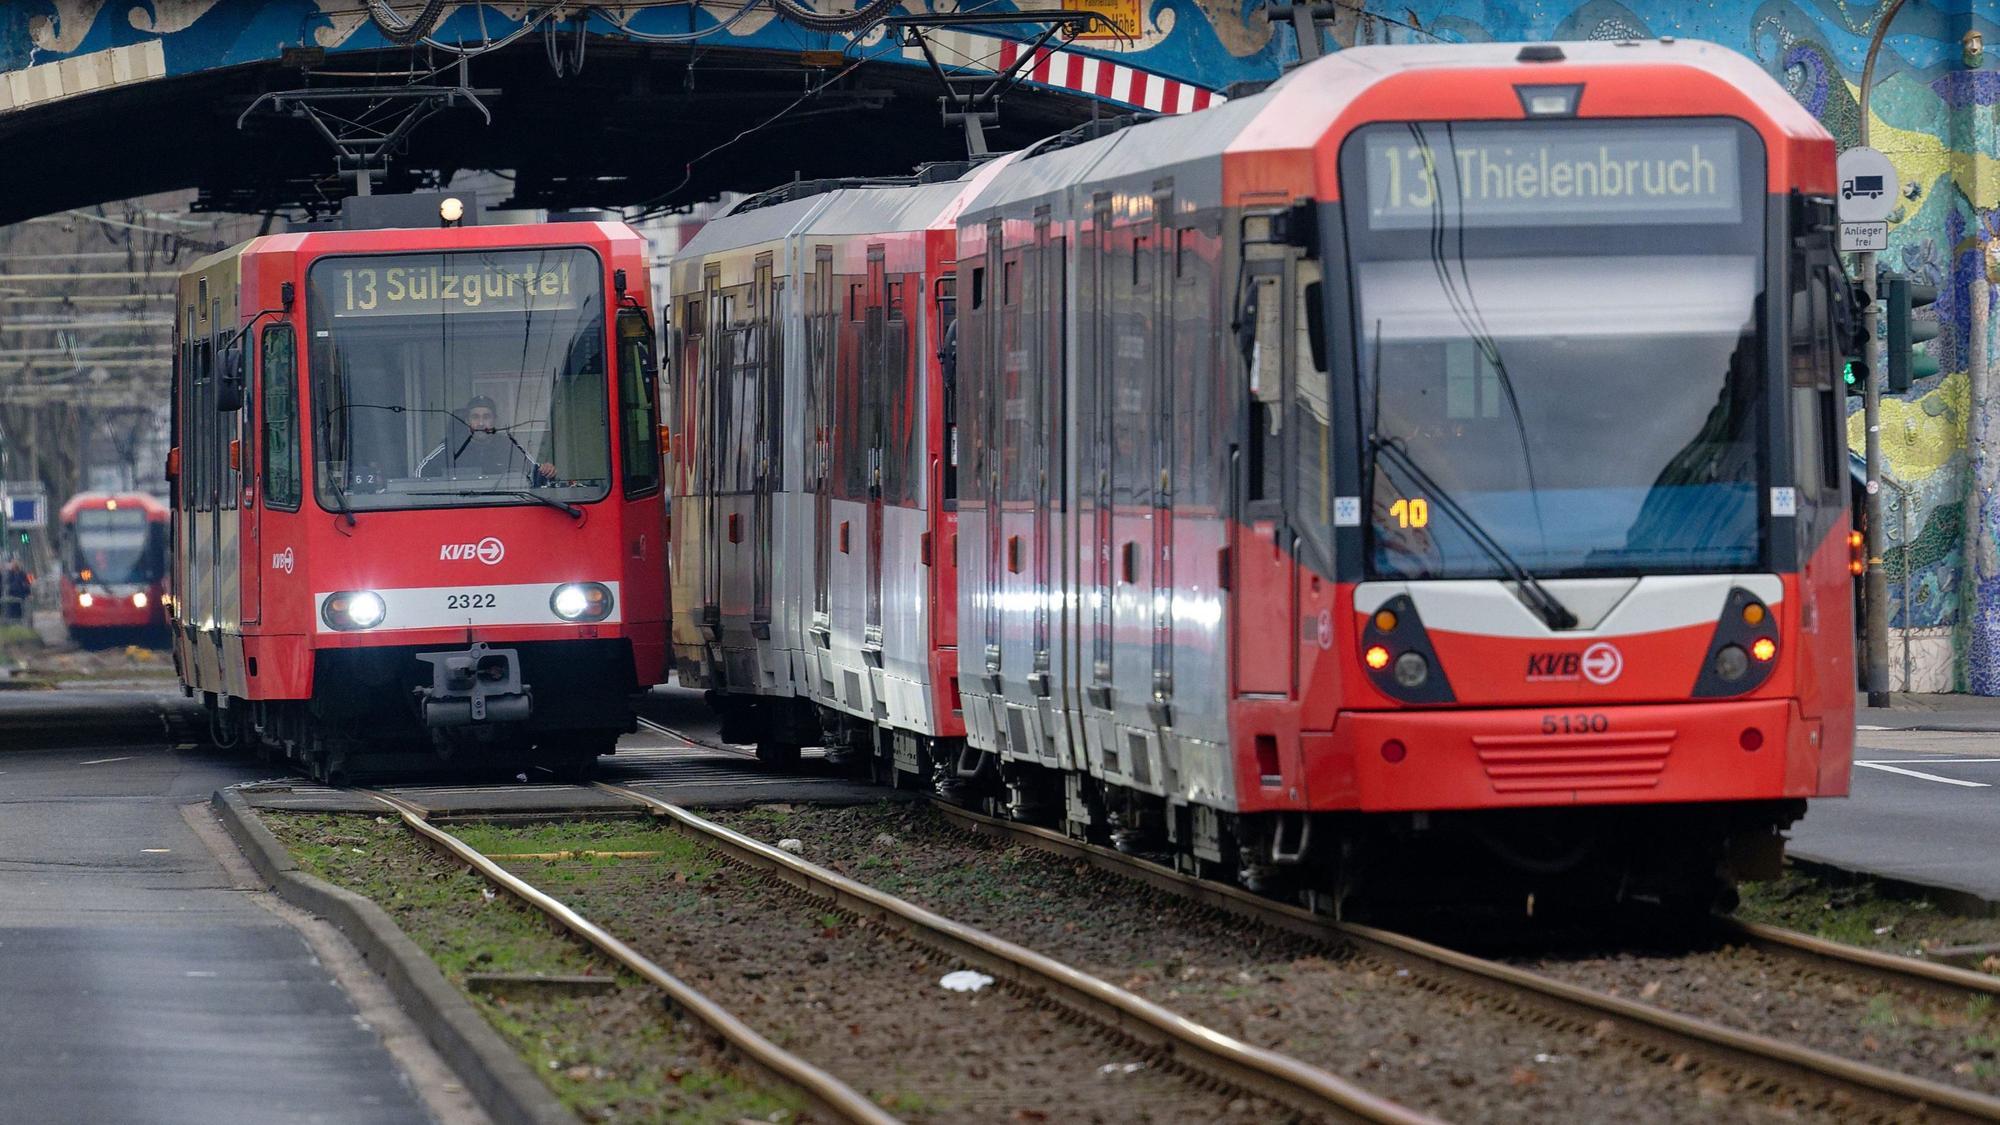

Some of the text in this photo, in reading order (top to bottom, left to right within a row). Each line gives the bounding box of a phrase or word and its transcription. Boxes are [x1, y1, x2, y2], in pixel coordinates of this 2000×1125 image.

[1385, 145, 1715, 208] 13 Thielenbruch
[1844, 227, 1883, 237] Anlieger
[1856, 238, 1871, 247] frei
[343, 262, 570, 310] 13 Sülzgürtel
[1389, 498, 1428, 528] 10
[440, 544, 477, 560] KVB
[447, 593, 496, 610] 2322
[1526, 653, 1580, 676] KVB
[1542, 713, 1608, 735] 5130
